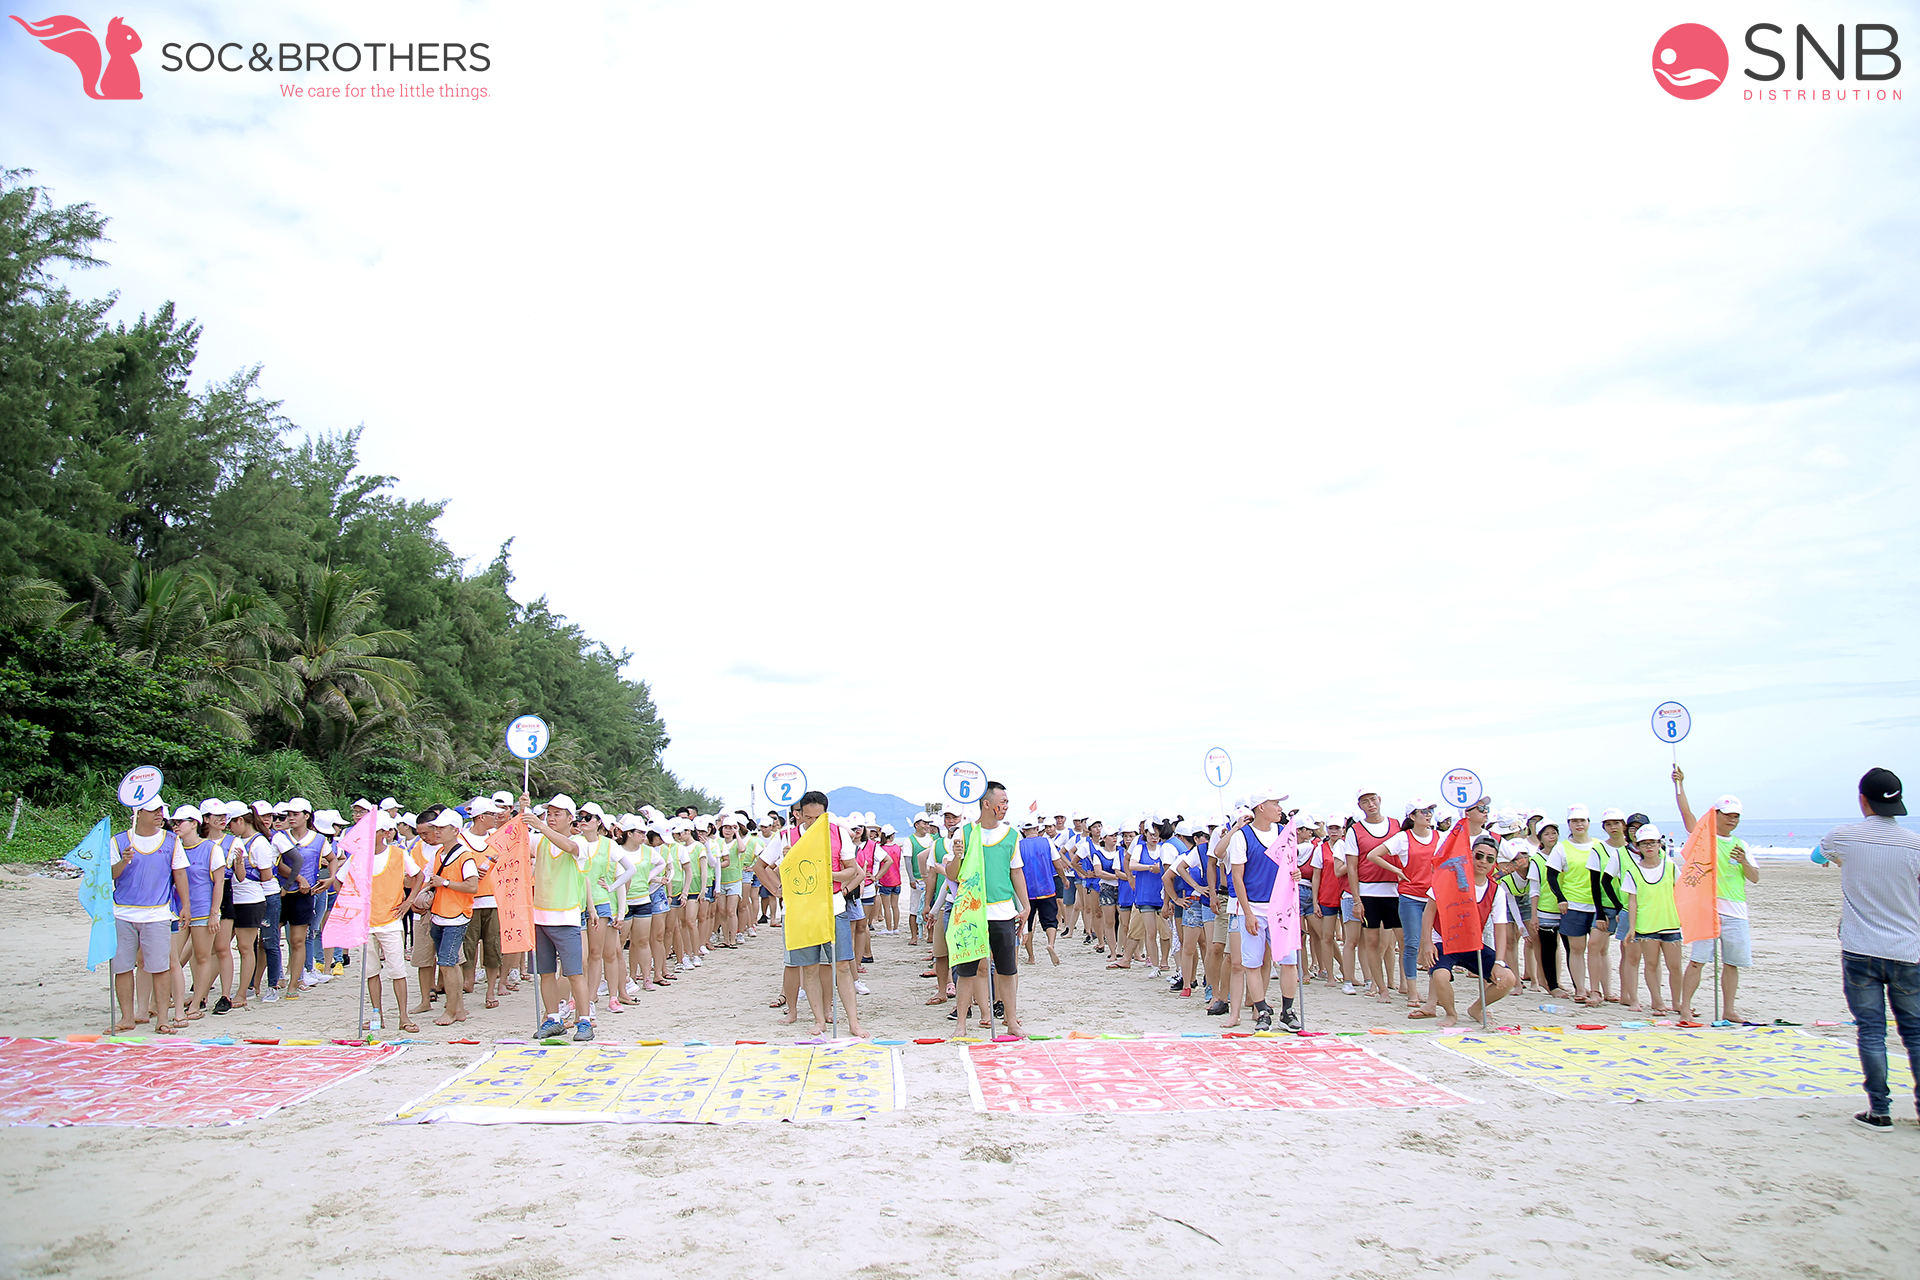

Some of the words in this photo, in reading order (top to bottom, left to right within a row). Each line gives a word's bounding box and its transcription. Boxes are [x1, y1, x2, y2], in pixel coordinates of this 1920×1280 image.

[1667, 720, 1677, 738] 8
[528, 735, 537, 753] 3
[1215, 765, 1222, 782] 1
[133, 784, 145, 801] 4
[781, 783, 792, 801] 2
[960, 780, 970, 798] 6
[1457, 786, 1467, 803] 5
